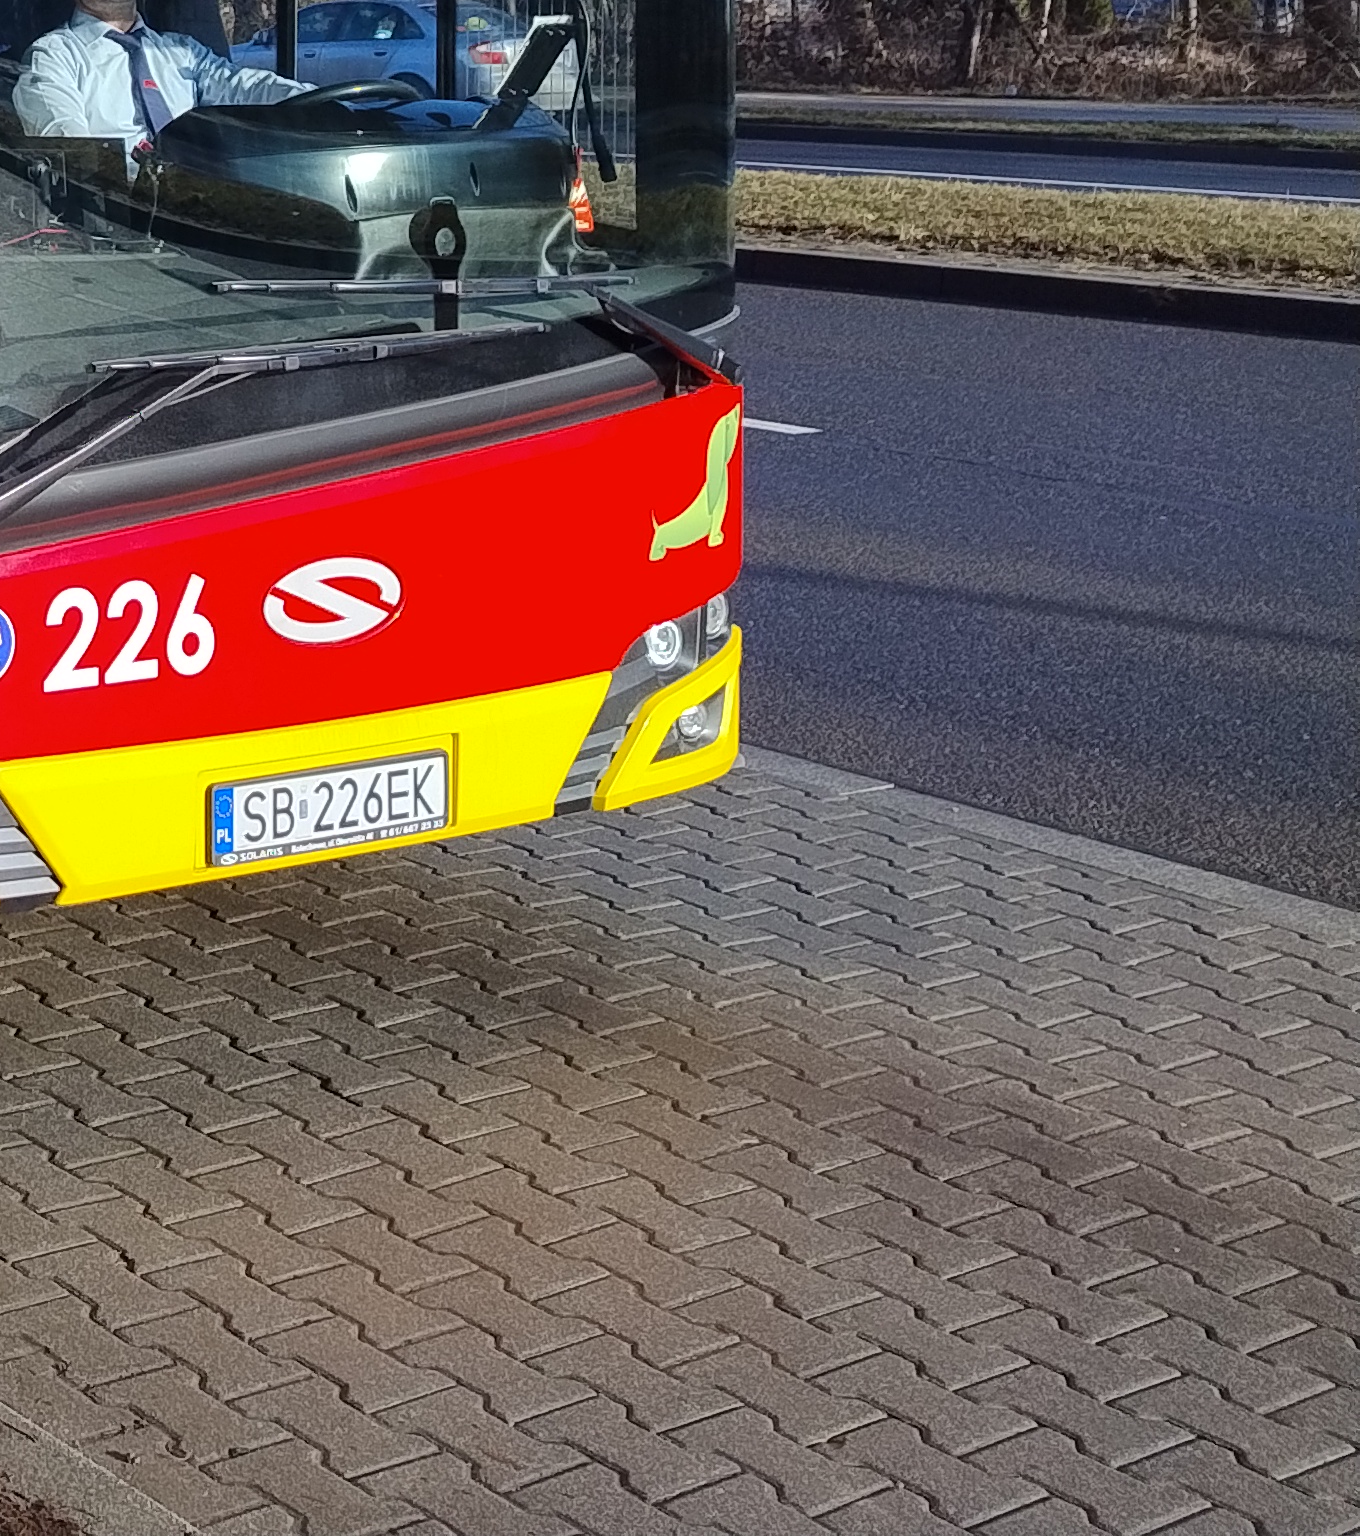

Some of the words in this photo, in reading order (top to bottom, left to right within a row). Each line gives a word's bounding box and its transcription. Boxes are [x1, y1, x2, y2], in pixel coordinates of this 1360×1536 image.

[43, 573, 215, 693] 226
[217, 828, 232, 844] PL
[243, 787, 295, 843] SB
[313, 764, 435, 833] 226EK
